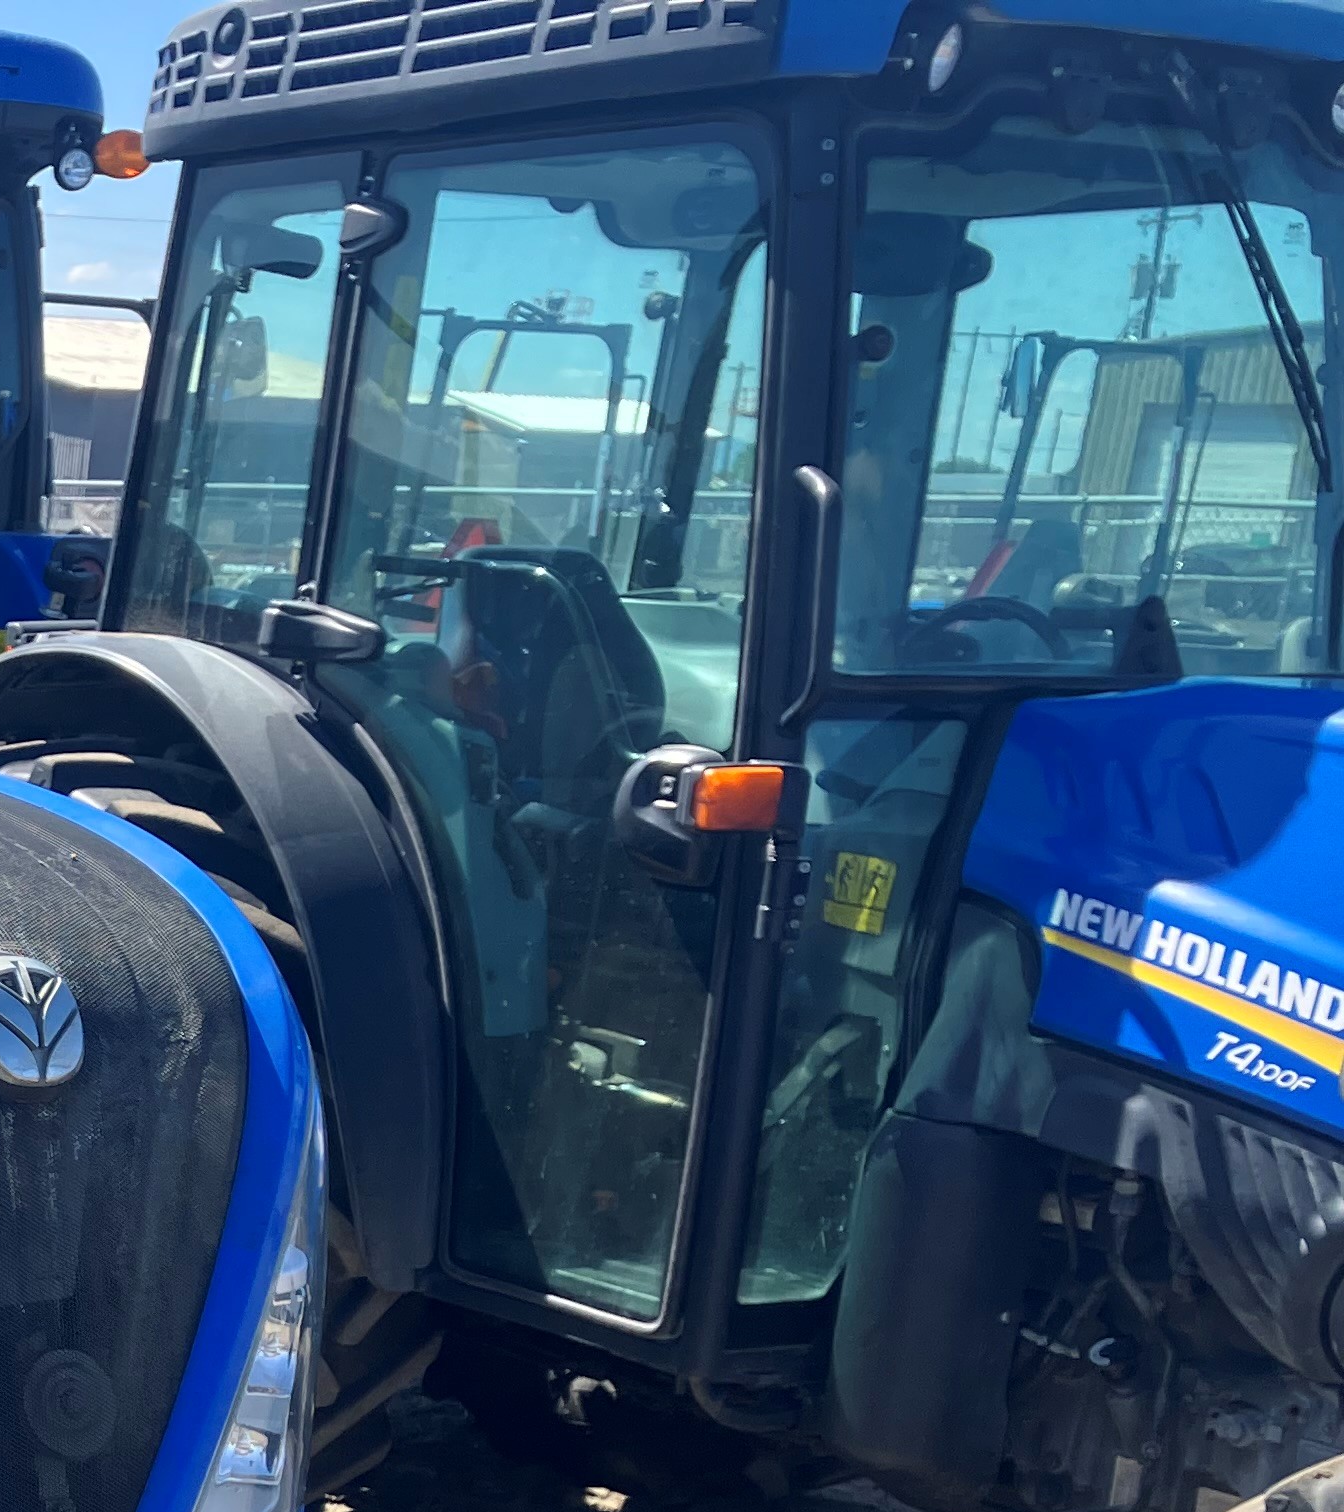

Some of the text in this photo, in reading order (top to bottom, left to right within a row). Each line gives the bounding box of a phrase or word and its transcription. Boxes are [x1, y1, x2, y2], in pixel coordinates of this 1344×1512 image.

[1050, 888, 1344, 1032] NEW HOLLAND
[1206, 1031, 1317, 1092] T4.100F
